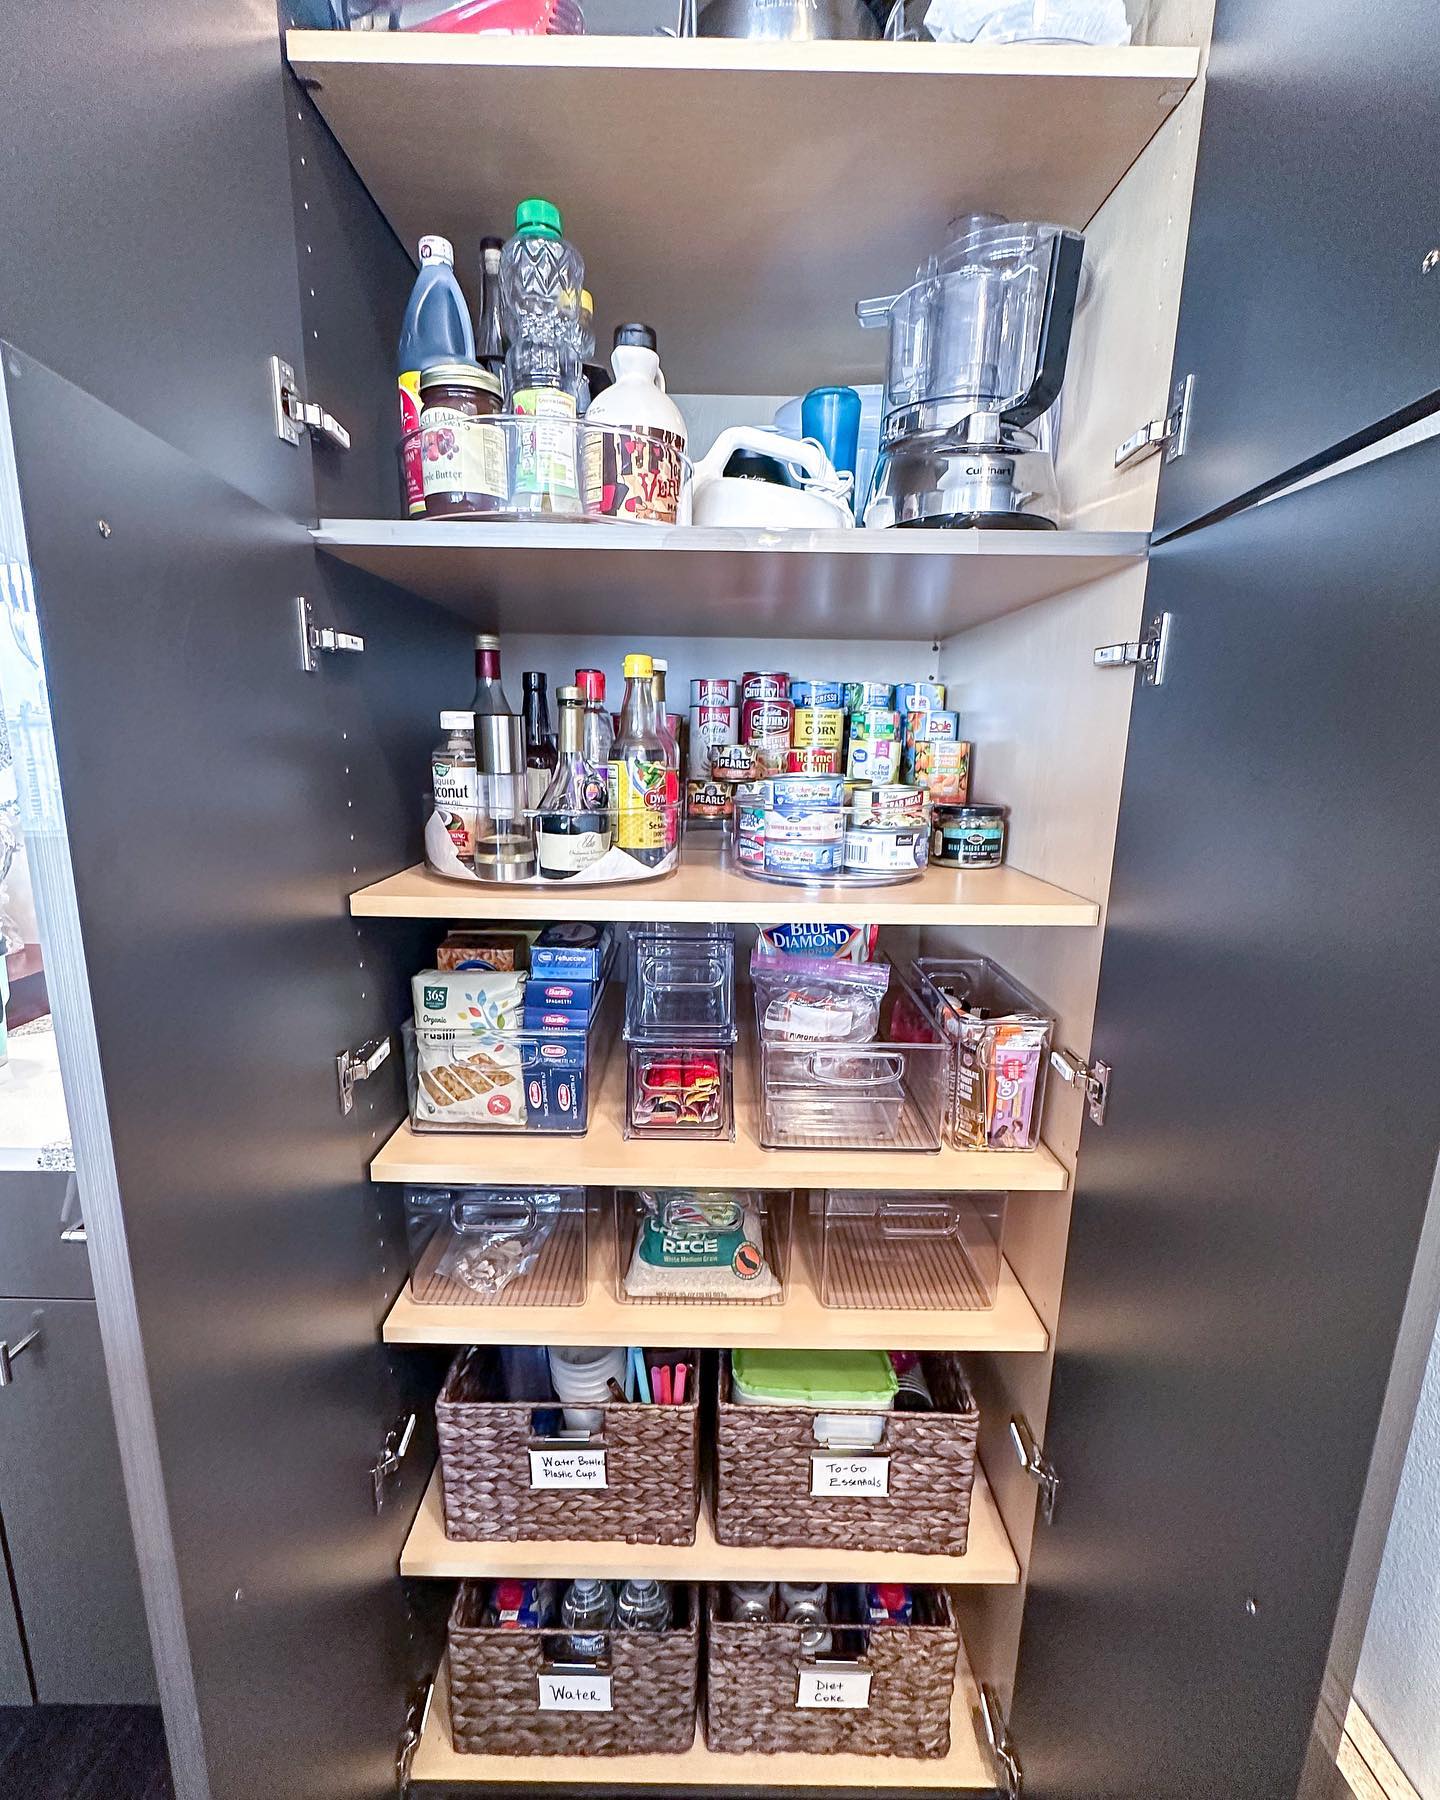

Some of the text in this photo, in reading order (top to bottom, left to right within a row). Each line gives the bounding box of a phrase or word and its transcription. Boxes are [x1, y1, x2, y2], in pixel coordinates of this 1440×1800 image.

[435, 471, 462, 479] Butter
[965, 467, 1011, 476] Cuinart
[701, 686, 728, 696] LIDSAY
[745, 687, 777, 698] CHUKY
[804, 693, 837, 705] PRGRESSO
[910, 697, 927, 706] Dle
[701, 712, 729, 723] LIDSAY
[930, 720, 951, 731] Dole
[720, 758, 750, 769] PEARLS
[695, 795, 725, 805] PEARLS
[790, 923, 829, 935] BLUE
[773, 928, 850, 948] DIAMOND
[426, 990, 445, 1002] 365
[423, 1014, 447, 1026] Organic
[662, 1238, 718, 1254] RICE
[663, 1255, 680, 1263] White
[681, 1255, 701, 1263] Medium
[541, 1456, 574, 1467] Water
[825, 1463, 867, 1473] To-Go
[543, 1468, 597, 1480] Plastic Cups
[829, 1476, 881, 1488] Essentials
[816, 1679, 844, 1691] Diet
[549, 1684, 601, 1702] Water
[814, 1692, 845, 1702] Coke
